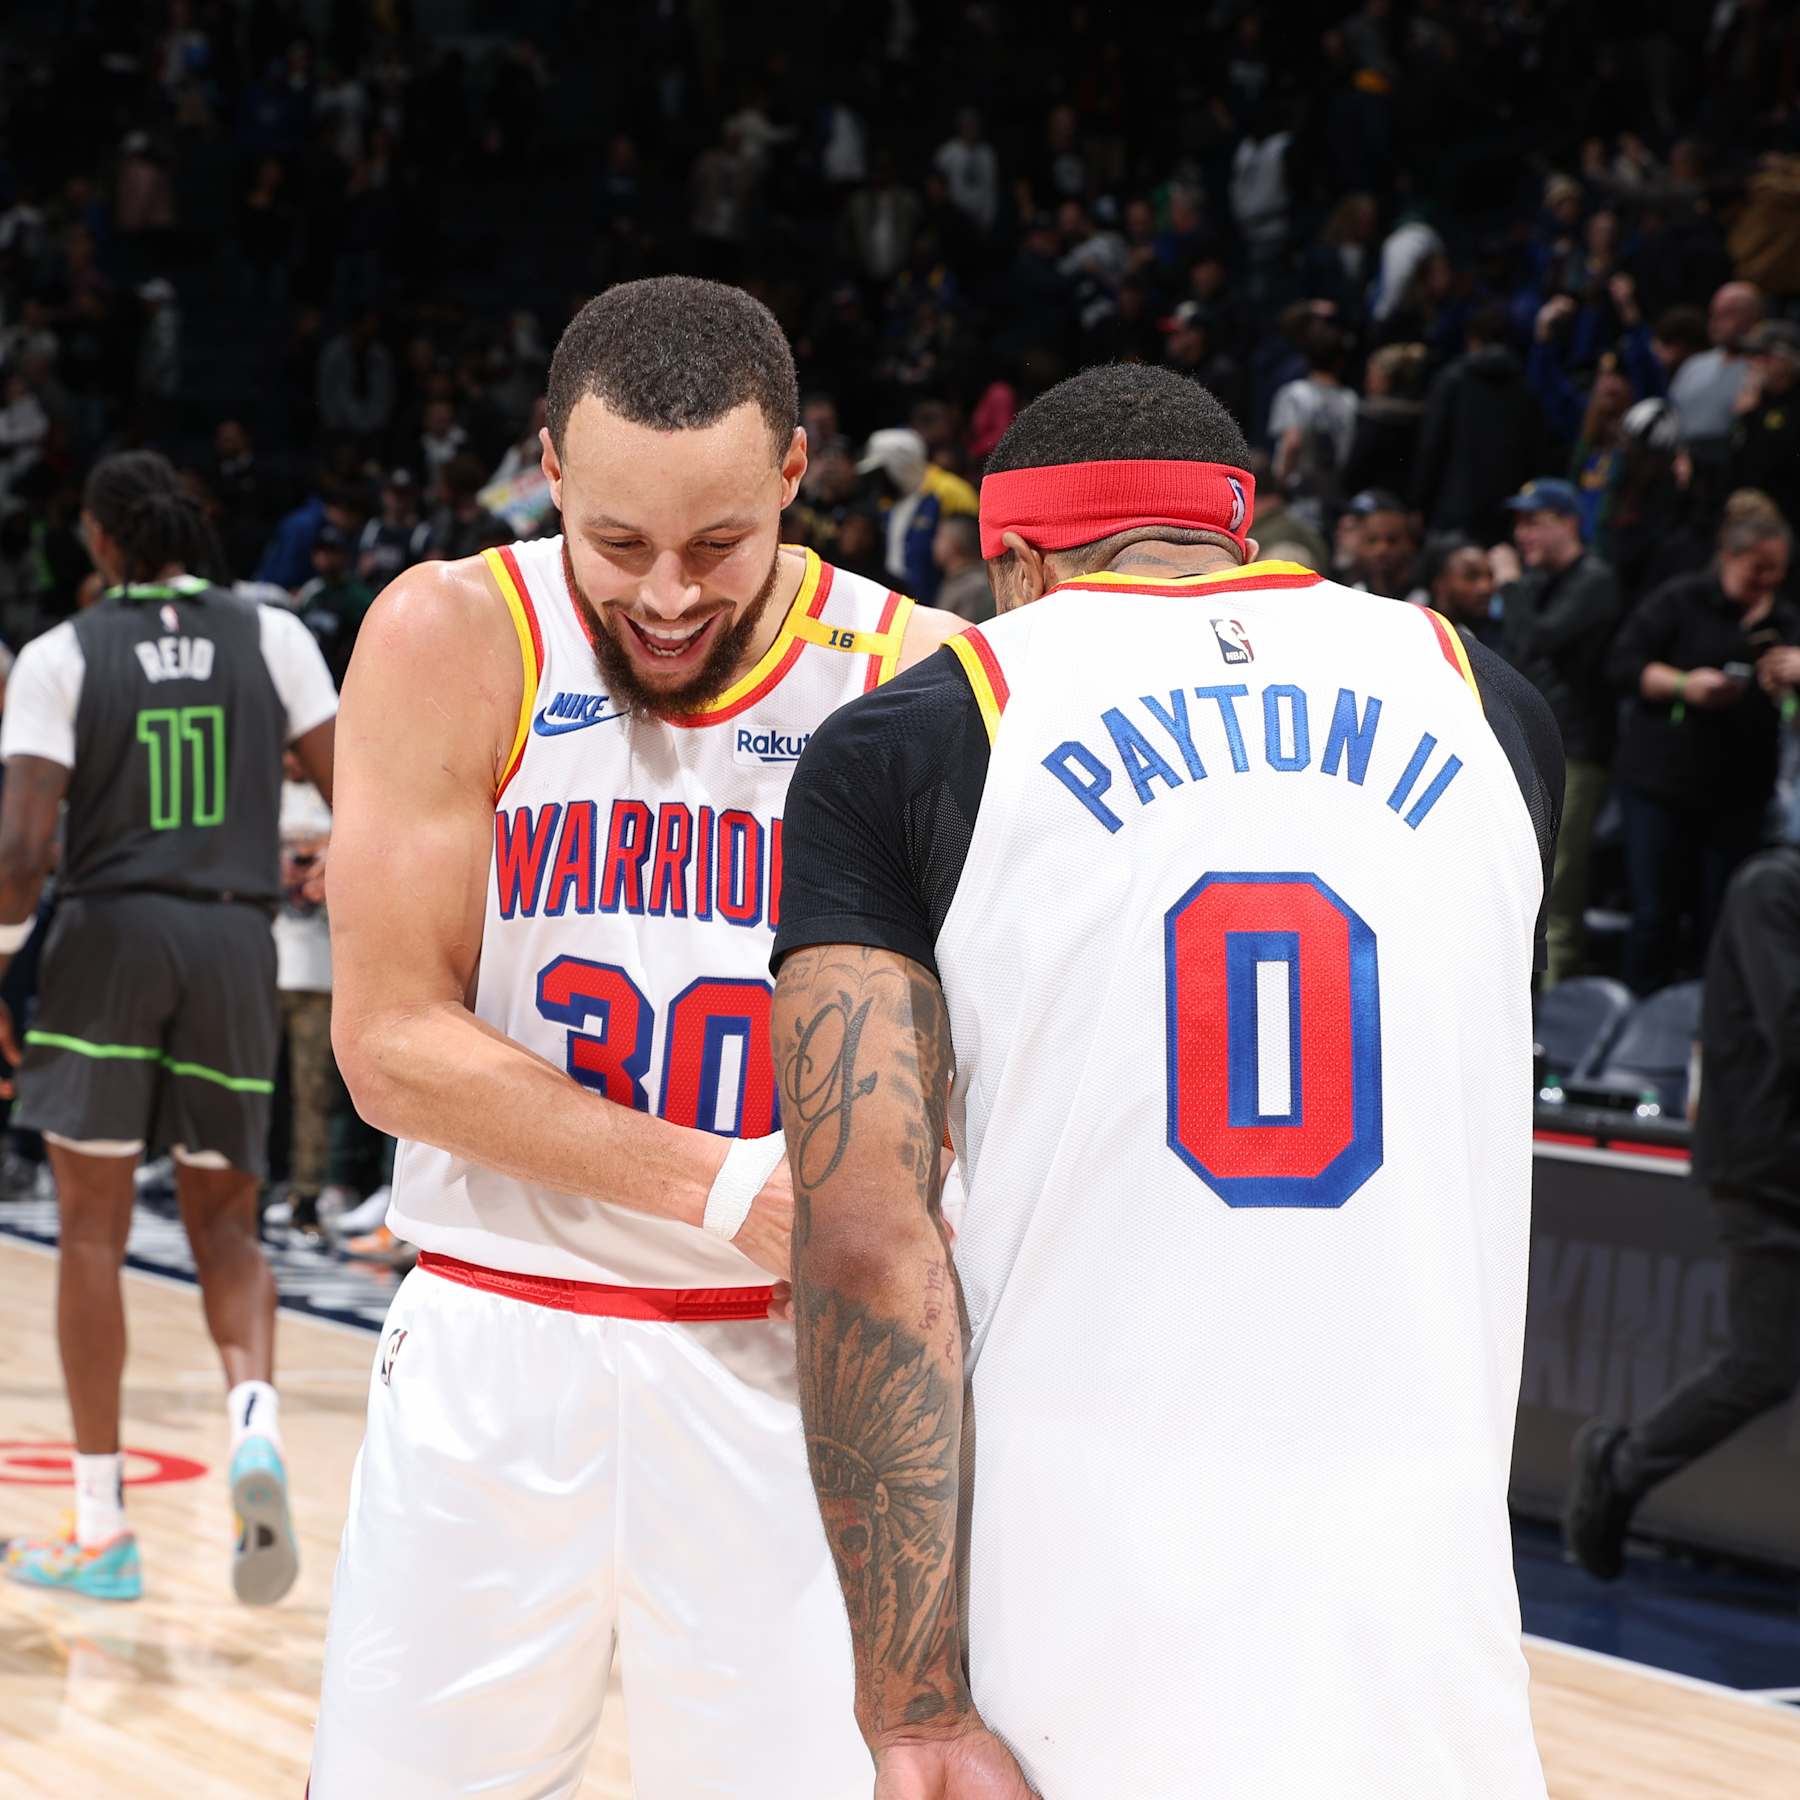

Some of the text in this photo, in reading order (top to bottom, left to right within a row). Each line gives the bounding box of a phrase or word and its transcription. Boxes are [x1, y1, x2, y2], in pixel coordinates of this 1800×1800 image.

[135, 637, 215, 683] REID
[828, 630, 855, 648] 16
[1225, 651, 1246, 661] NBA
[547, 692, 609, 722] NIKE
[137, 706, 227, 830] 11
[1041, 683, 1463, 834] PAYTON II
[535, 953, 783, 1140] 30
[1164, 870, 1384, 1208] 0
